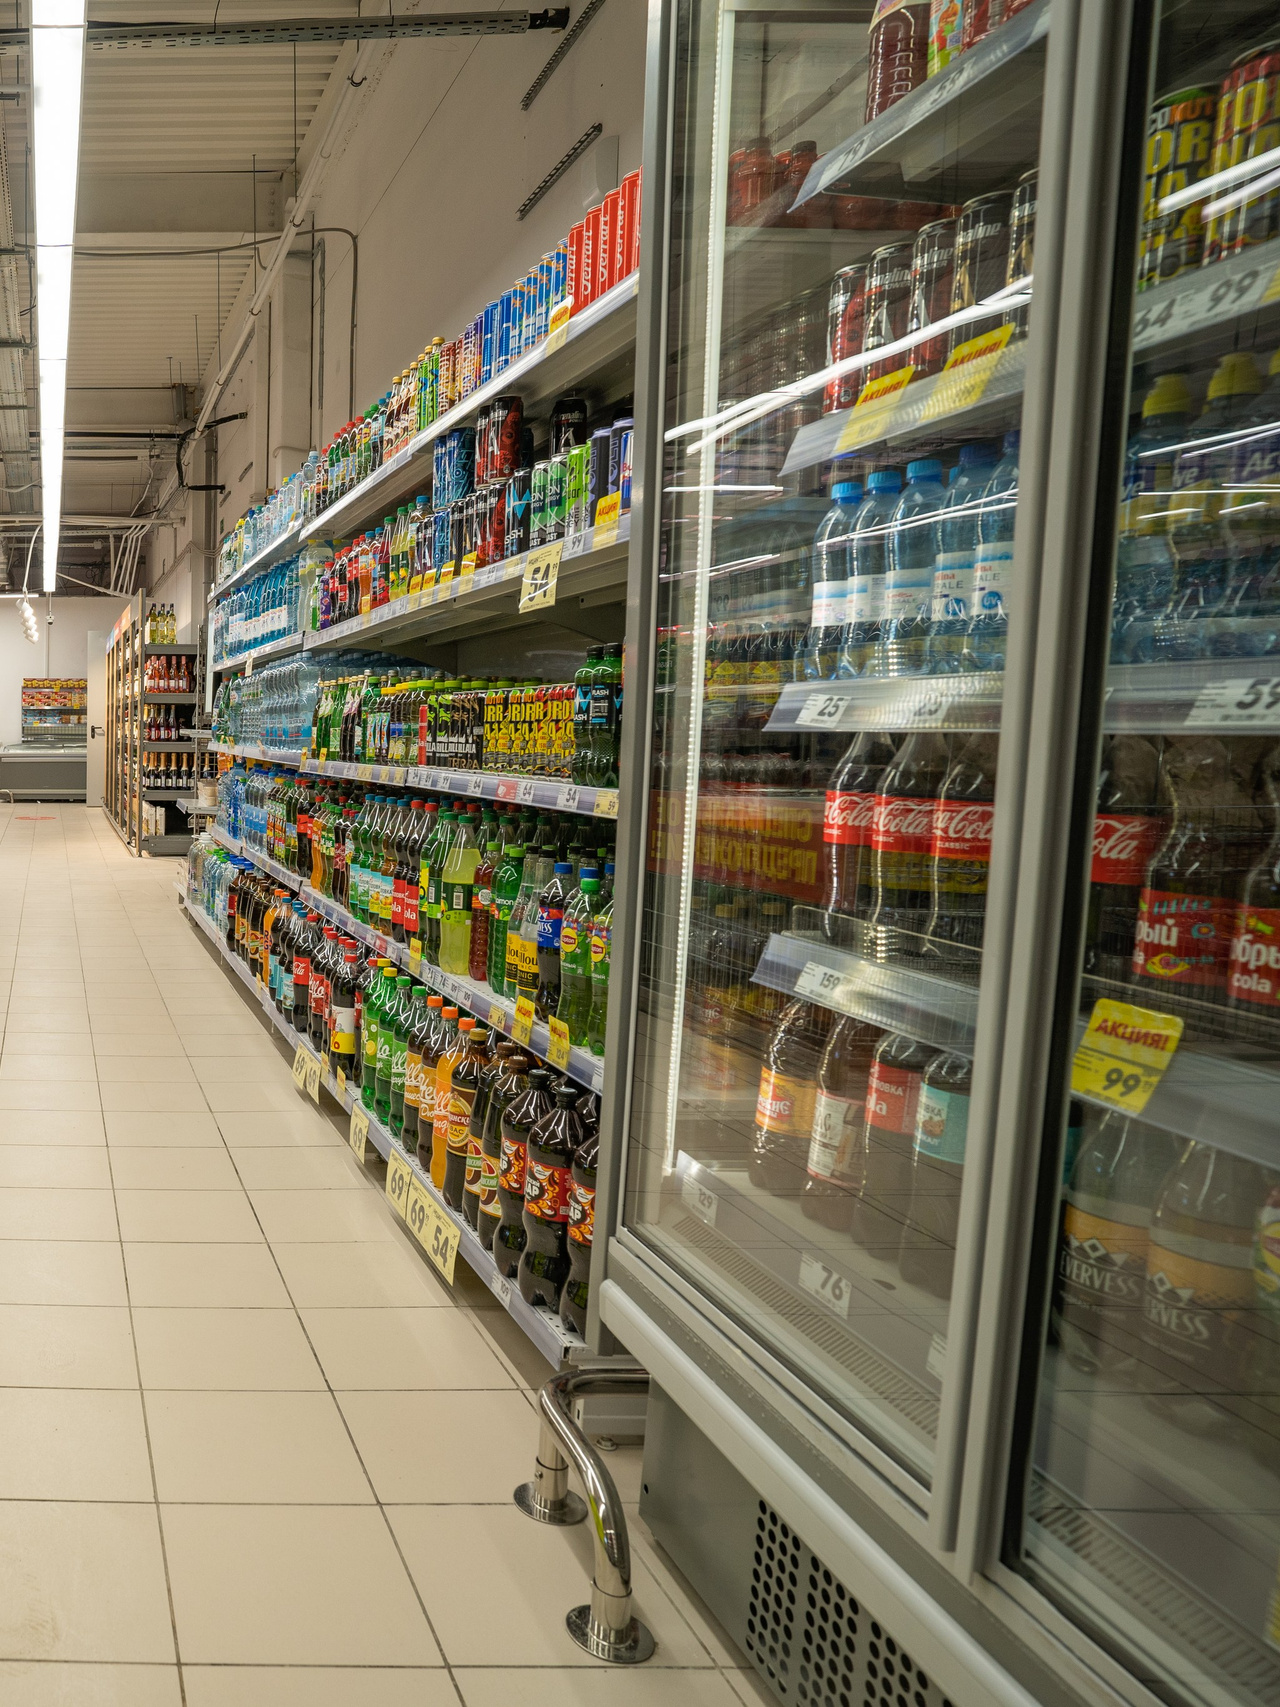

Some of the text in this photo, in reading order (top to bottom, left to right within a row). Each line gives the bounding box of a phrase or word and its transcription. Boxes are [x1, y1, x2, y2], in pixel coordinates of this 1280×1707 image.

[1208, 268, 1260, 312] 99
[860, 379, 905, 407] АКЦИЯ!
[597, 501, 618, 517] АКЦИЯ!
[527, 562, 551, 602] 54
[817, 696, 844, 717] 25
[566, 788, 578, 803] 54
[819, 971, 841, 991] 159
[1232, 973, 1272, 994] cola
[1095, 1018, 1170, 1051] АКЦИЯ!
[296, 1053, 305, 1070] 69
[1102, 1067, 1141, 1098] 99
[353, 1123, 363, 1145] 69
[391, 1169, 404, 1201] 69
[698, 1188, 713, 1209] 129
[410, 1202, 425, 1233] 69
[432, 1228, 449, 1268] 54
[500, 1281, 509, 1295] 109
[820, 1265, 843, 1301] 76
[1060, 1250, 1142, 1301] EVERVESS
